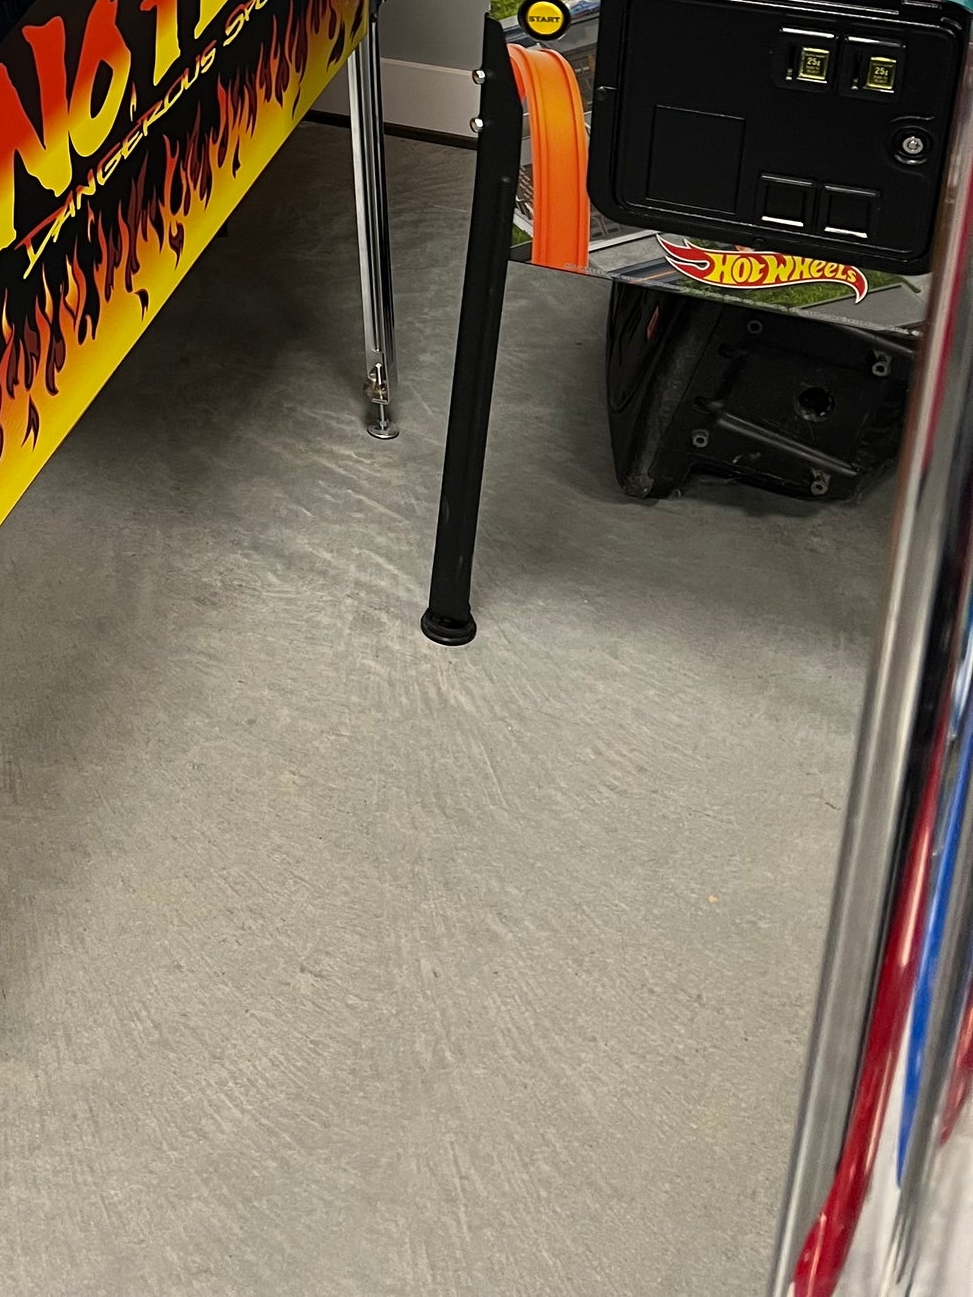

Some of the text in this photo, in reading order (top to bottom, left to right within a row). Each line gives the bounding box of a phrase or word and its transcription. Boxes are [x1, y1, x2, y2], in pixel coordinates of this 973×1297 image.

[13, 39, 217, 279] DANGEROUS
[705, 252, 858, 285] HOT WHEELS
